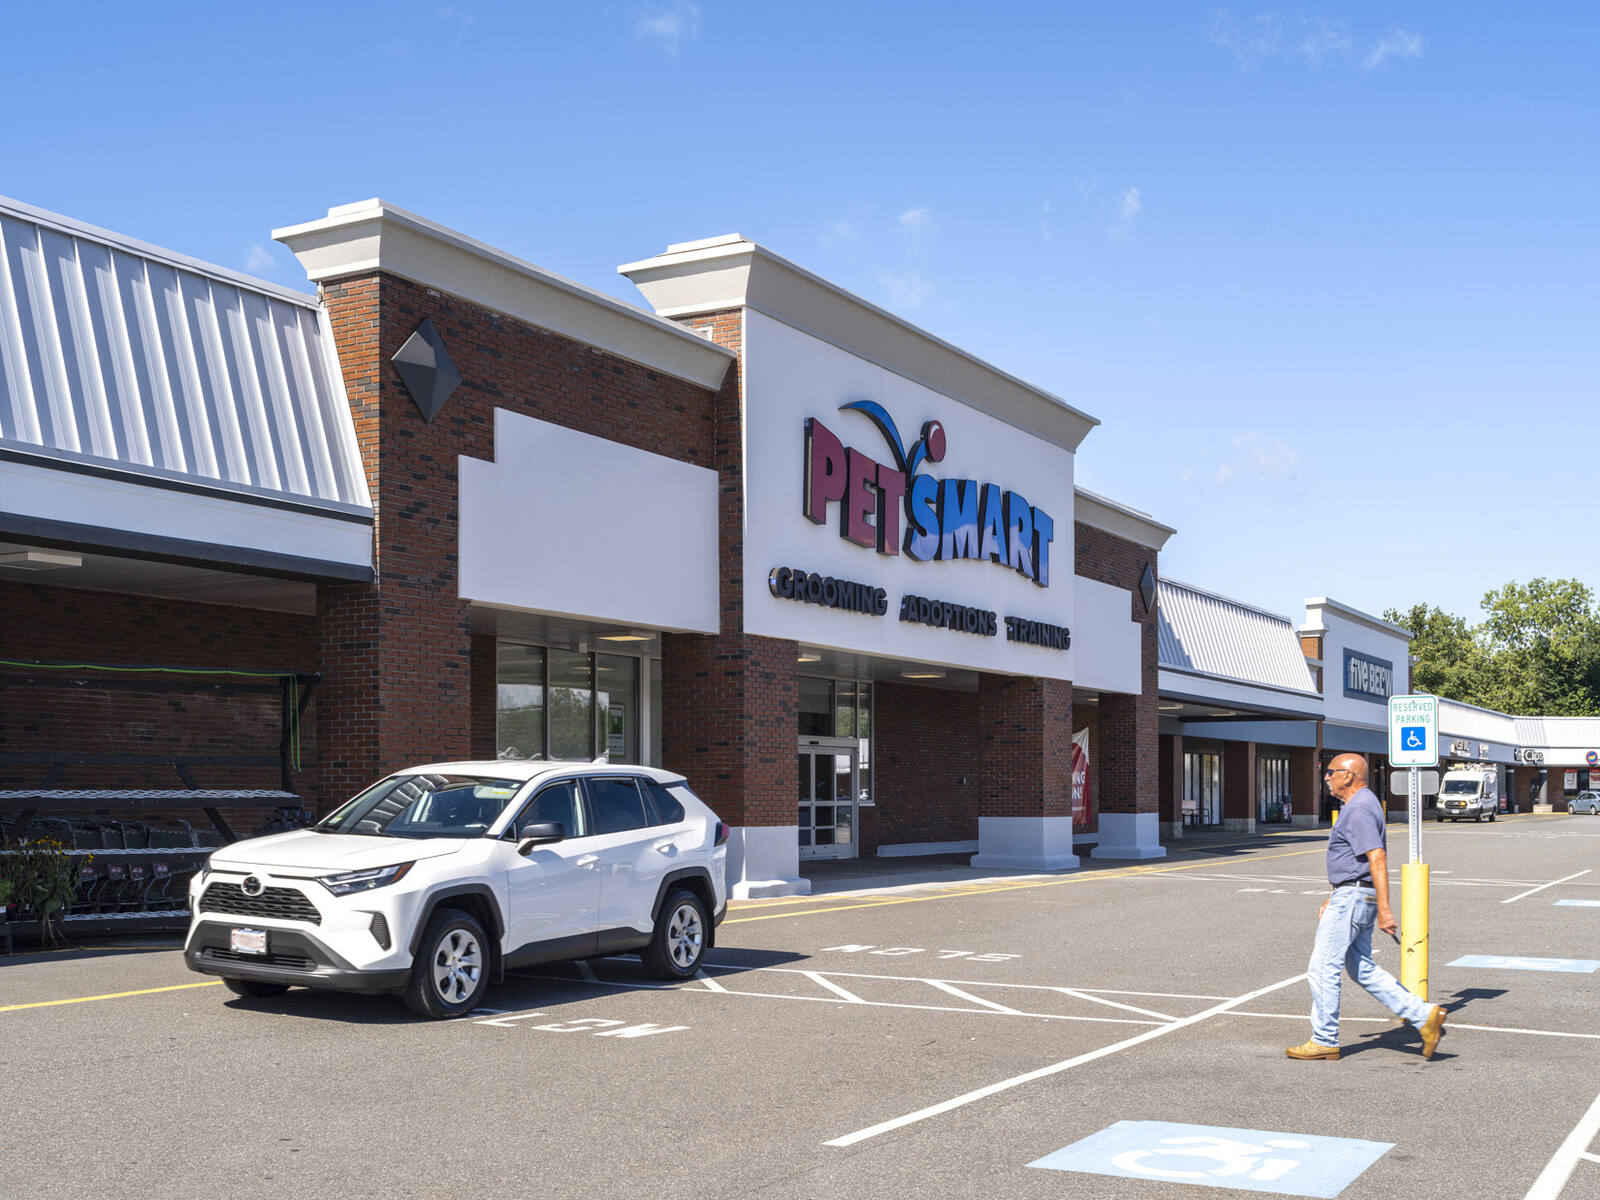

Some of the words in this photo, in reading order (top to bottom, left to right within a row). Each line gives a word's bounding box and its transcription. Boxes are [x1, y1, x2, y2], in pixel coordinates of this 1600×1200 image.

[804, 416, 1054, 588] PETSMART
[769, 567, 887, 616] GROOMING
[900, 595, 996, 636] ADOPTIONS
[1005, 616, 1070, 650] TRAINING
[1393, 702, 1433, 712] RESERVED
[1395, 714, 1431, 724] PARKING
